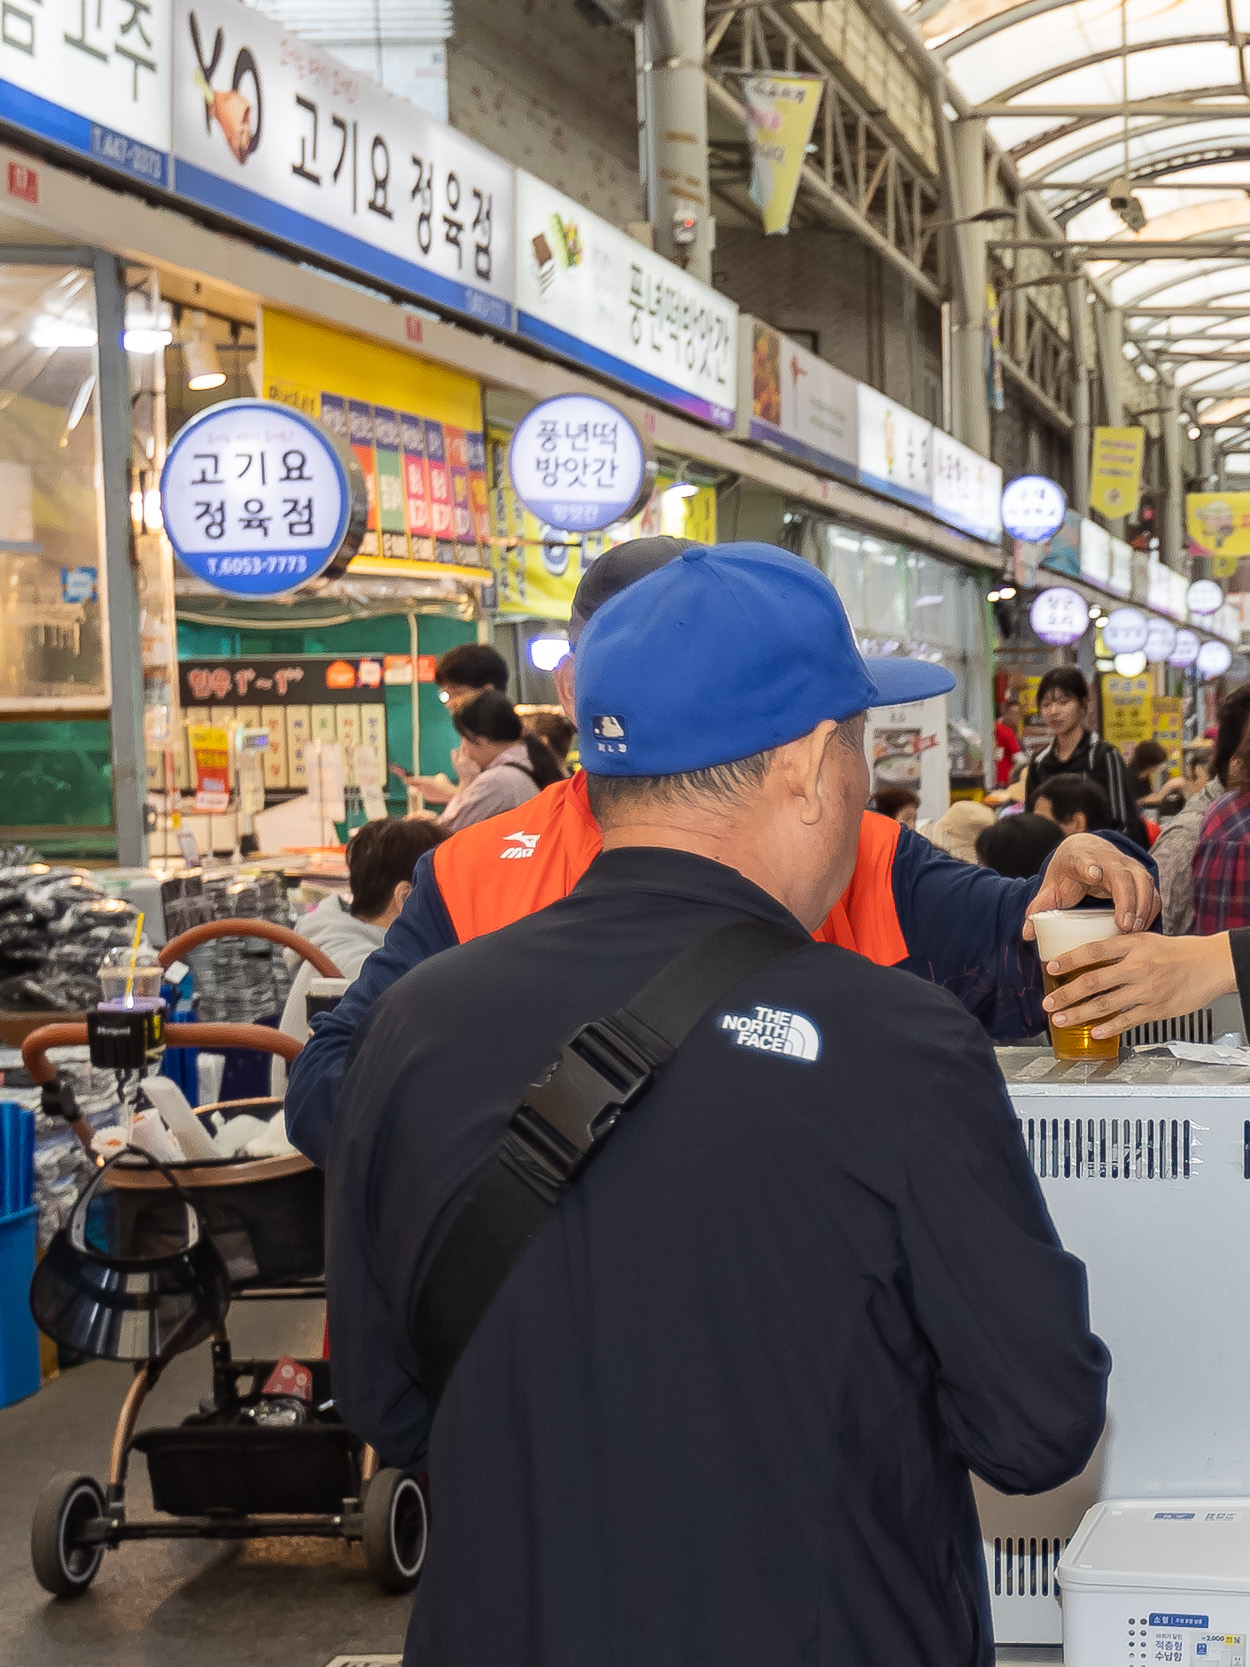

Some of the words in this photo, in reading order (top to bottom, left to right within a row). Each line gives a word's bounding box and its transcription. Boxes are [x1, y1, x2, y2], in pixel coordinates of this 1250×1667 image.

[291, 92, 394, 221] 고기요
[410, 153, 493, 282] 정육점
[536, 419, 618, 453] 풍년떡
[191, 449, 313, 486] 고기요
[535, 454, 619, 489] 방앗간
[194, 496, 314, 540] 정육점
[721, 1015, 788, 1039] NORTH
[755, 1006, 791, 1026] THE
[736, 1031, 784, 1052] FACE
